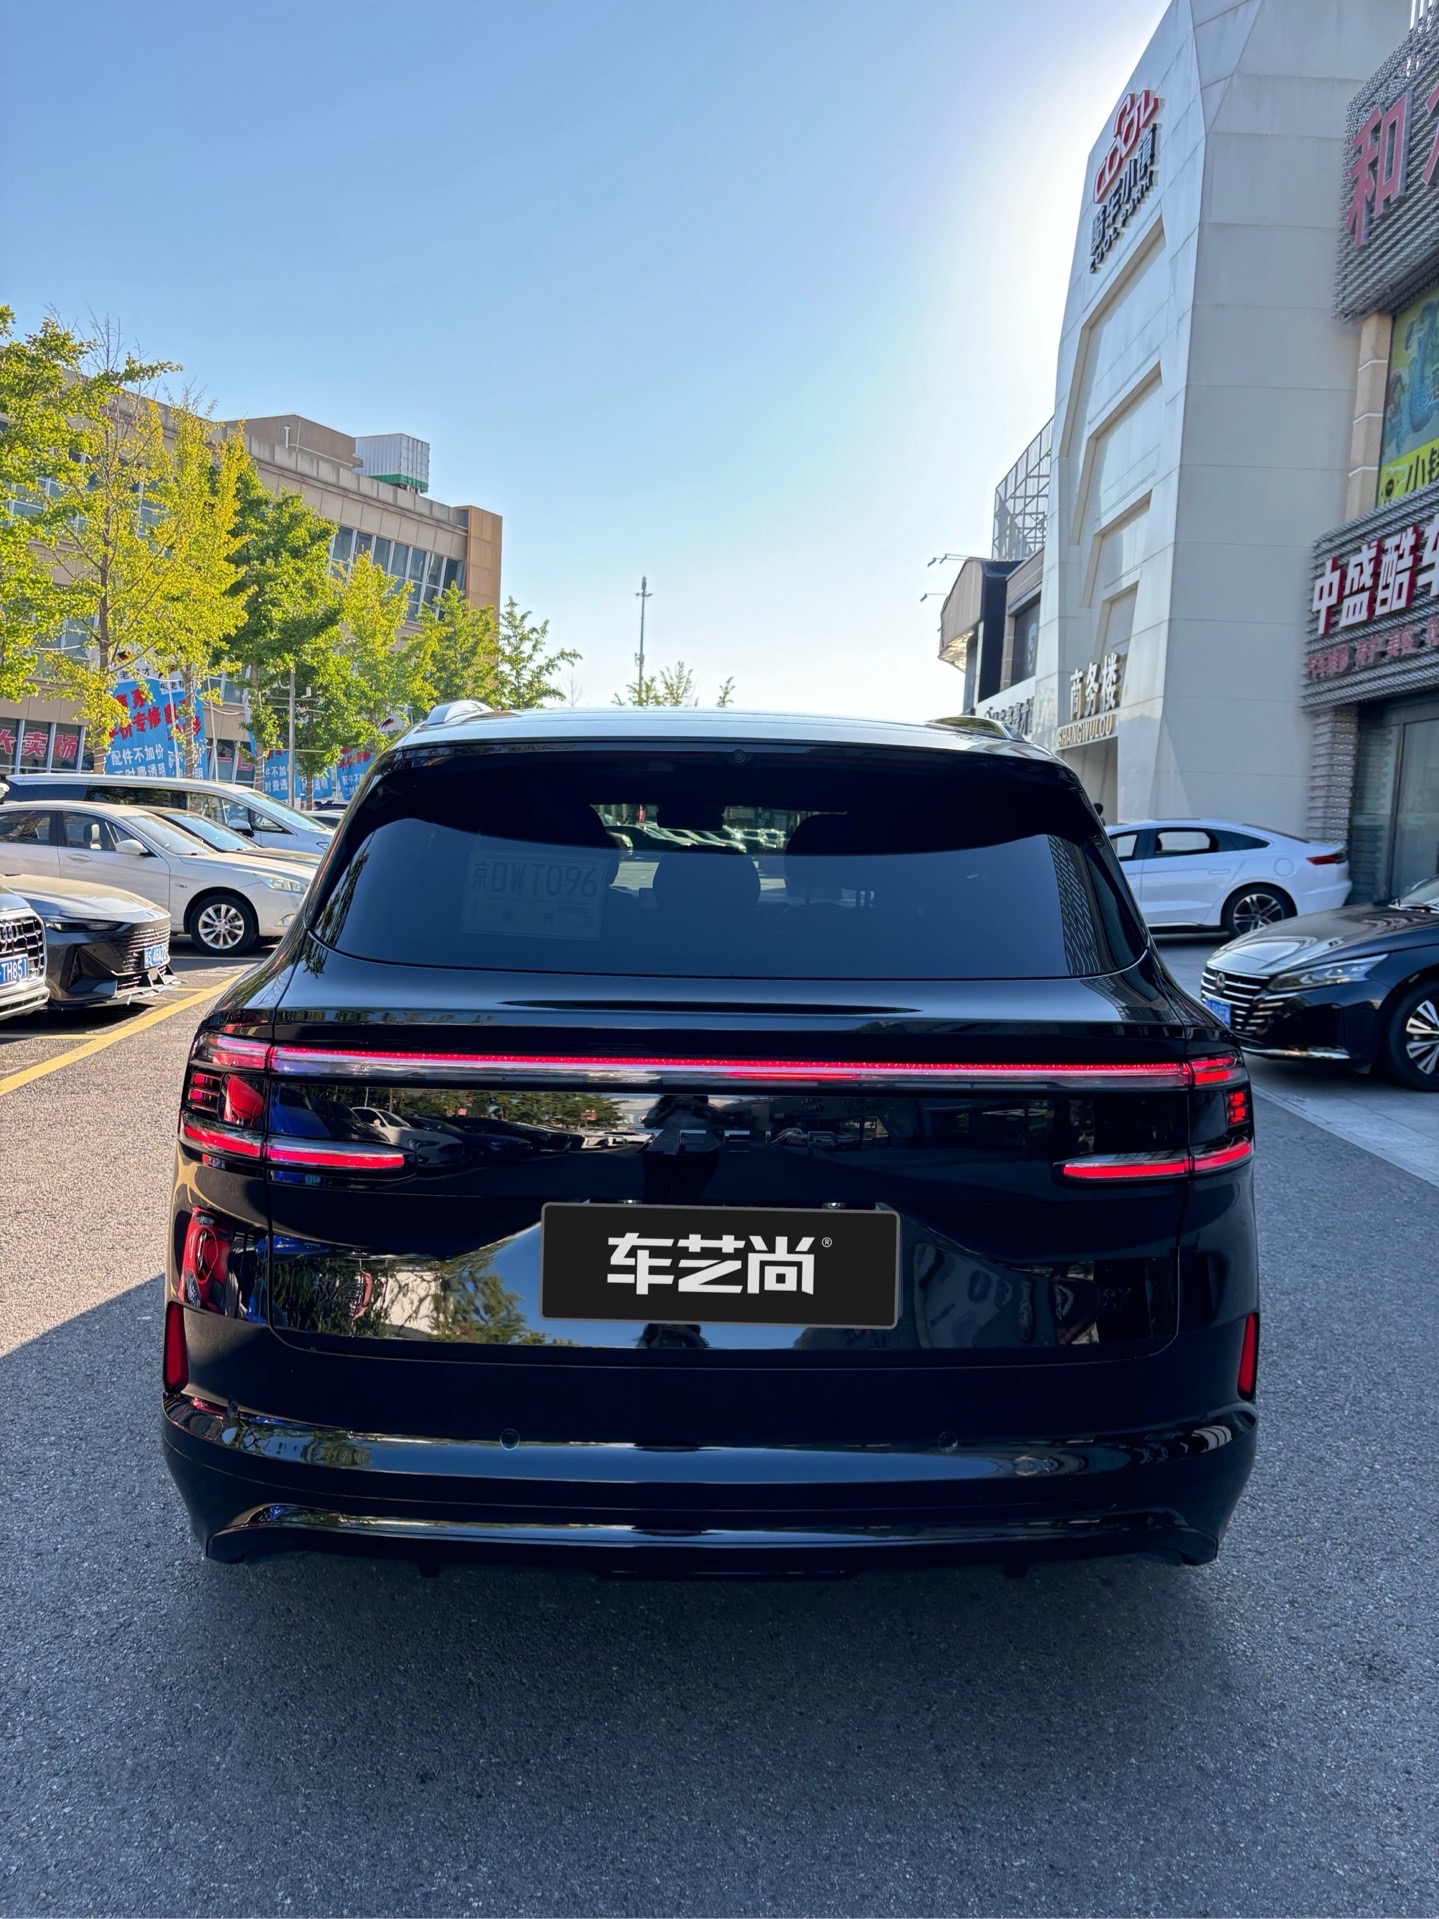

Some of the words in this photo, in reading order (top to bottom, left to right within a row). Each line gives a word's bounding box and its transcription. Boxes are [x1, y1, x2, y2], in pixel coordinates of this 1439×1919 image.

[1345, 84, 1439, 247] 和
[1070, 653, 1120, 719] 商务楼
[1057, 713, 1115, 748] SHANGWULOU
[111, 743, 164, 766] 配件不加价
[0, 957, 27, 983] TH851
